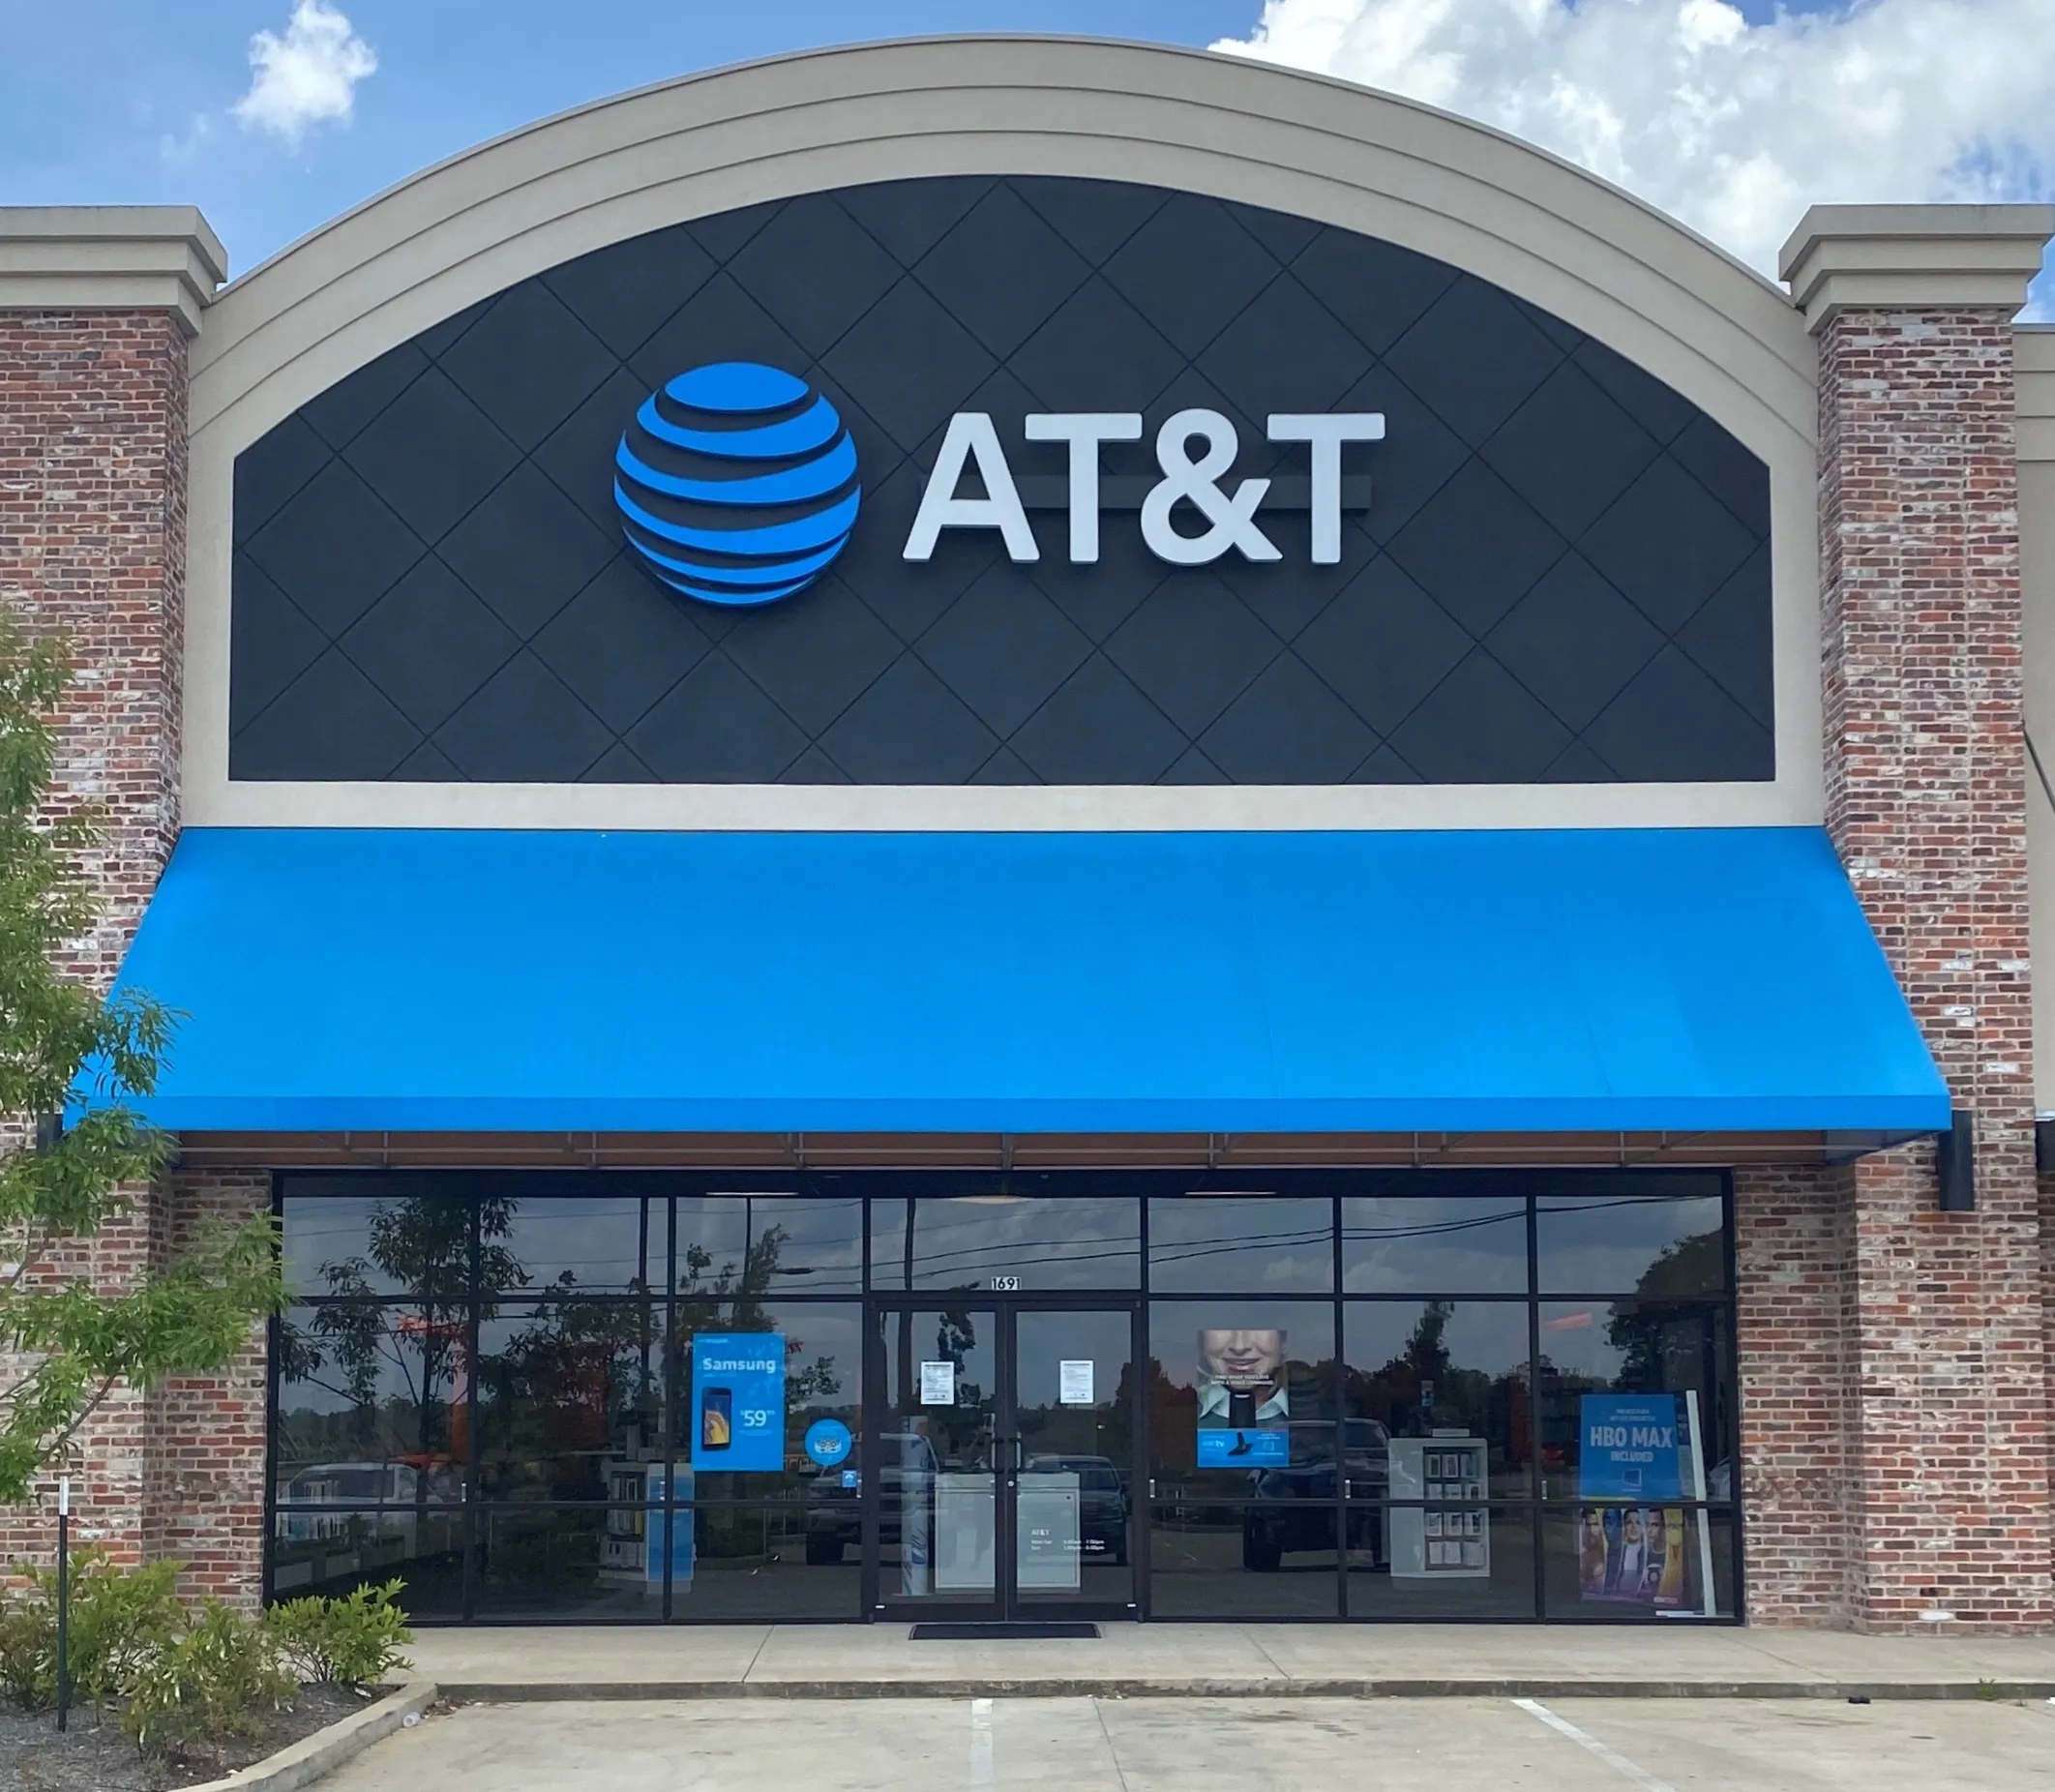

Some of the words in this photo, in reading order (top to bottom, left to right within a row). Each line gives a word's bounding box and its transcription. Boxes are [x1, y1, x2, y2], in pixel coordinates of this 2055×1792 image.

[903, 407, 1385, 566] AT&T
[992, 1277, 1021, 1290] 1691
[702, 1358, 776, 1374] Samsung
[1590, 1426, 1627, 1448] HBO
[1631, 1426, 1673, 1449] MAX
[1610, 1450, 1654, 1462] INCLUDED
